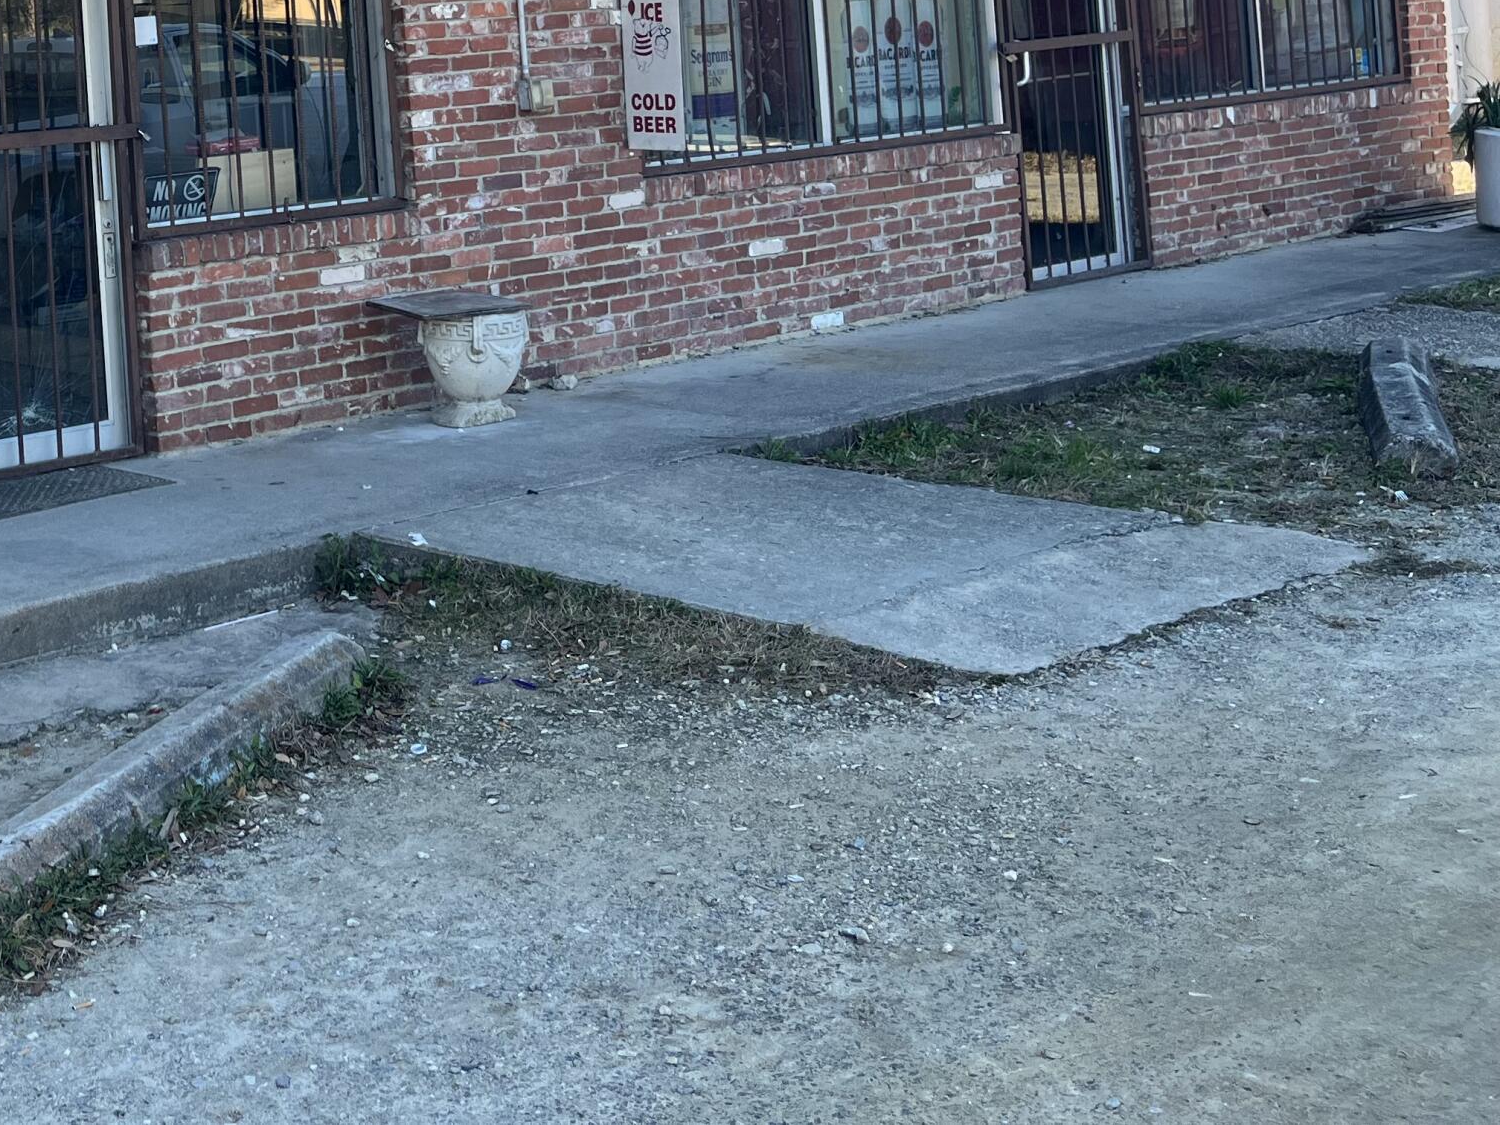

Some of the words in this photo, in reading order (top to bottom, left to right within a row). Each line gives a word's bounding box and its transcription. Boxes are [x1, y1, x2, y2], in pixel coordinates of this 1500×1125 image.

[640, 2, 663, 23] ICE
[631, 92, 676, 111] COLD
[633, 116, 677, 134] BEER
[152, 178, 177, 202] NO
